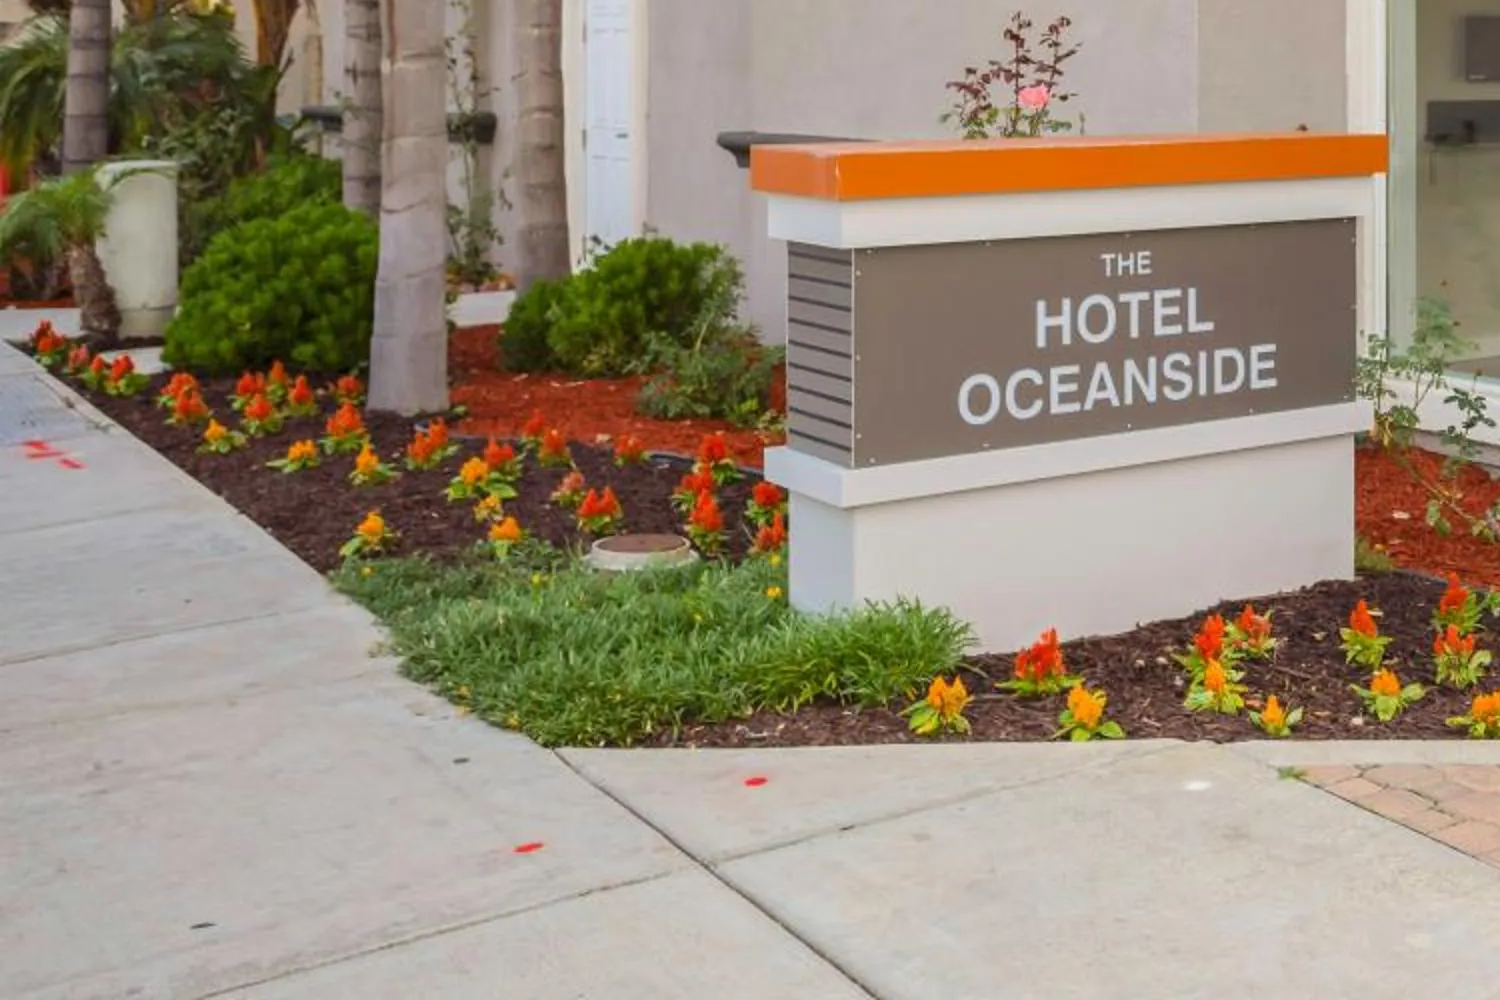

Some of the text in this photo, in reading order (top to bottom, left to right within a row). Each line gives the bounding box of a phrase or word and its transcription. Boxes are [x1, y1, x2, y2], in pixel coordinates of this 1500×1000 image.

[1100, 250, 1153, 278] THE
[1035, 286, 1215, 349] HOTEL
[957, 342, 1278, 426] OCEANSIDE
